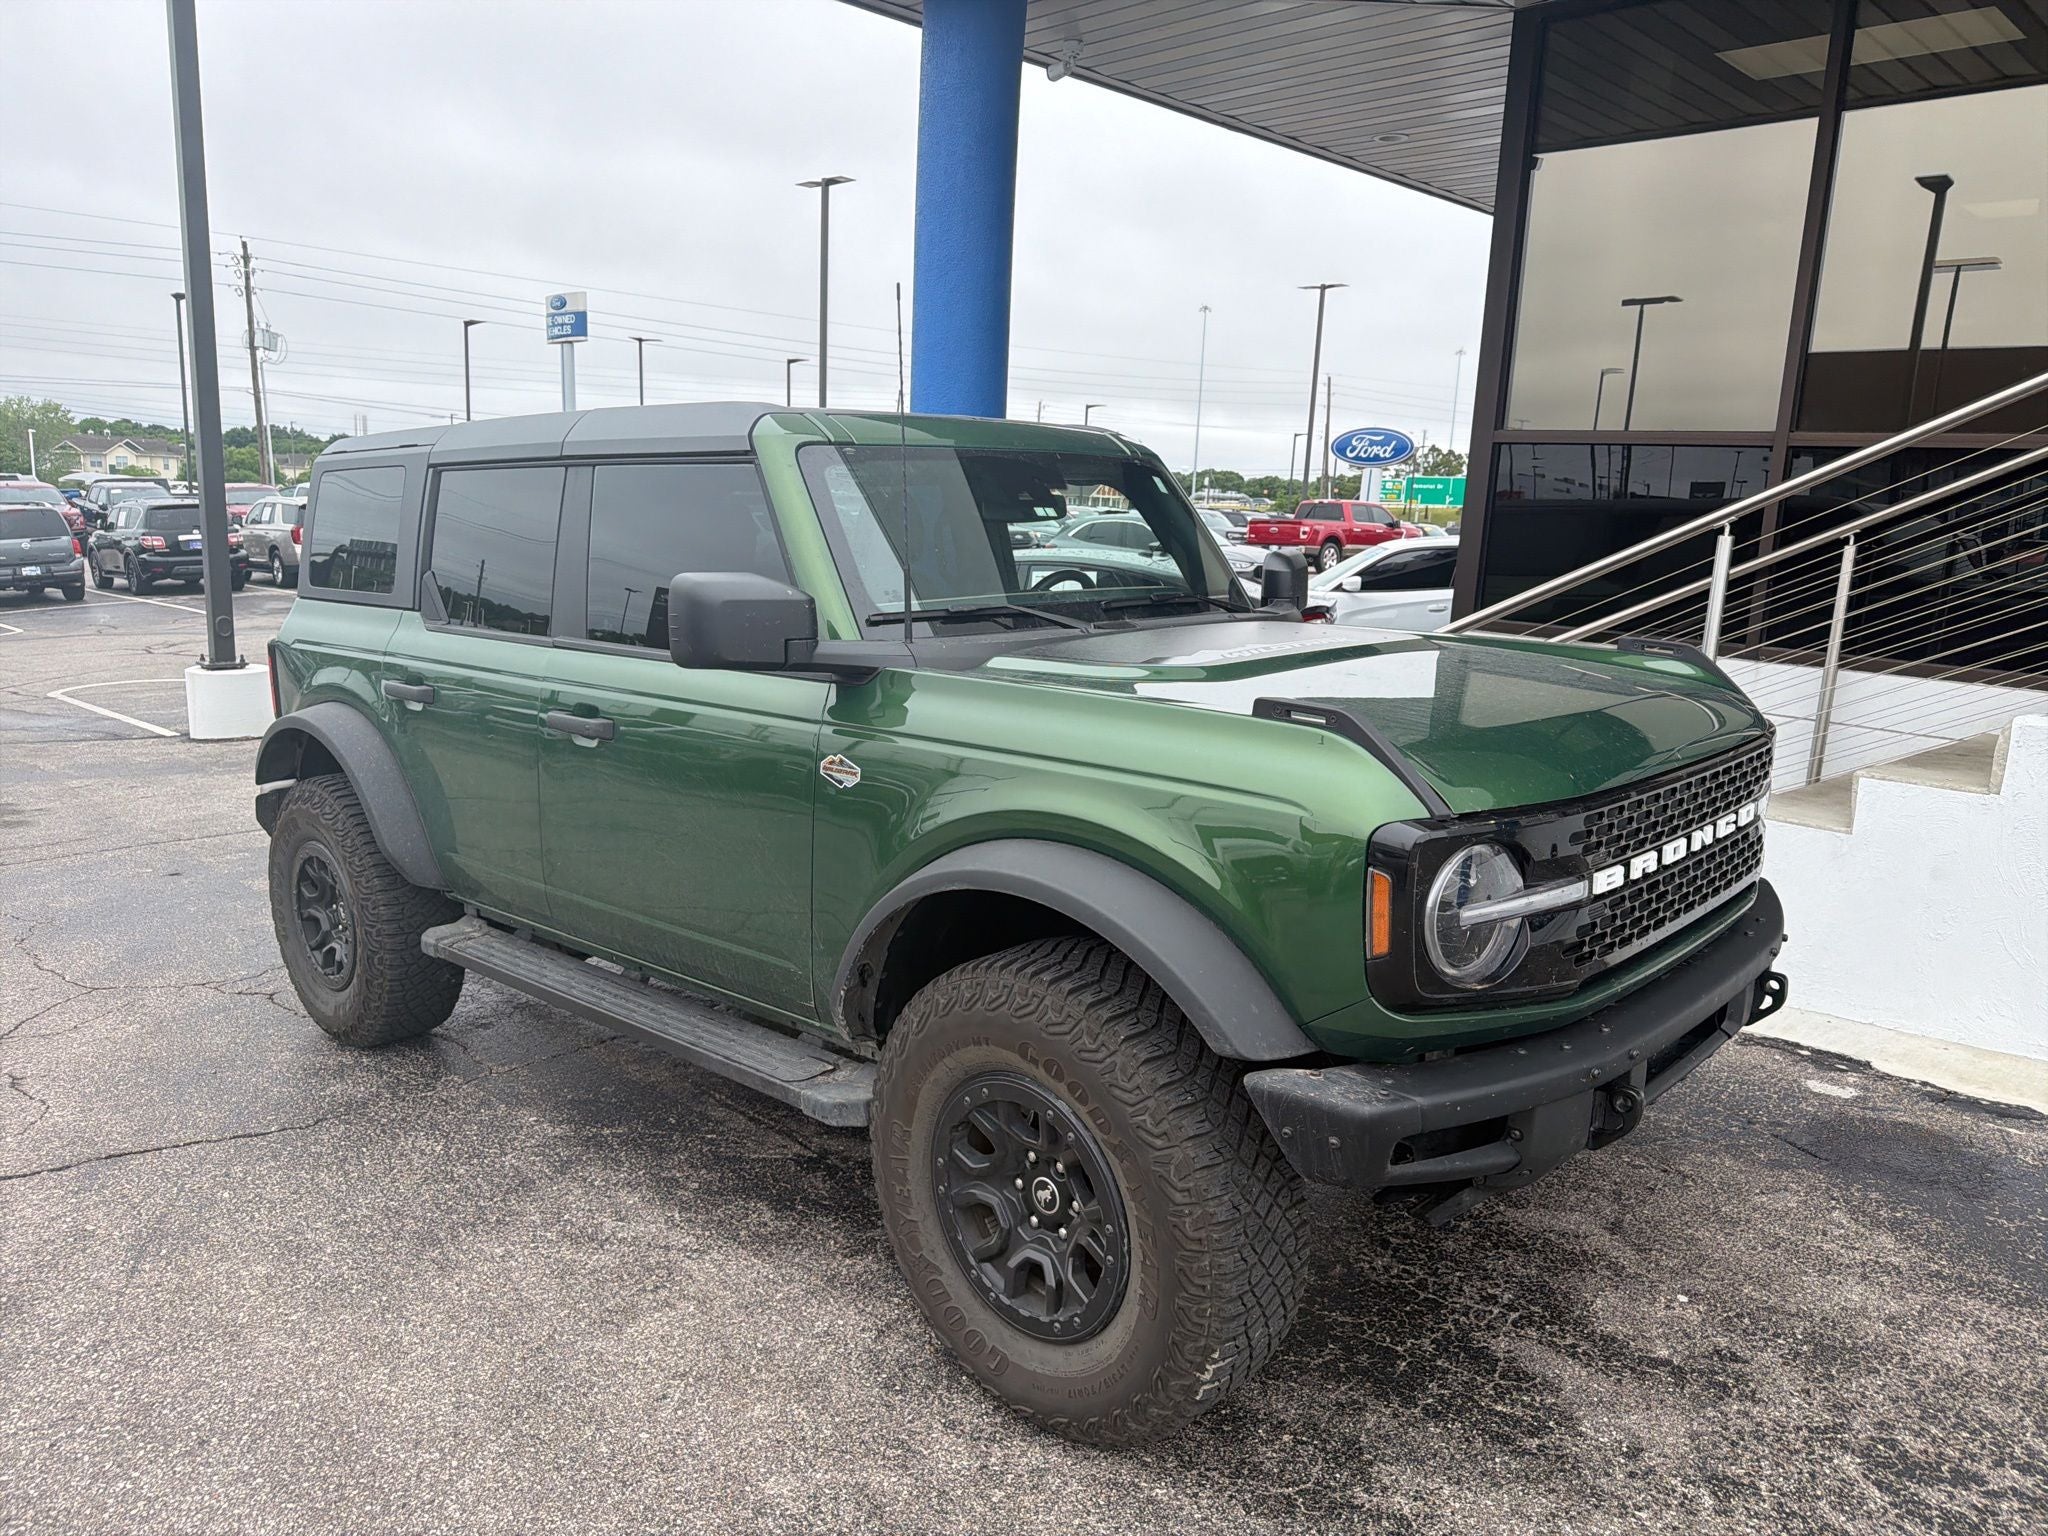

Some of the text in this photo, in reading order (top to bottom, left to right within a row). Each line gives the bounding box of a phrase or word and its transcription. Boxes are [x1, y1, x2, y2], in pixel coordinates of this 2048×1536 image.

[1346, 434, 1397, 458] Ford
[1592, 802, 1756, 895] BRONCO
[889, 1119, 1010, 1377] GOODYEAR
